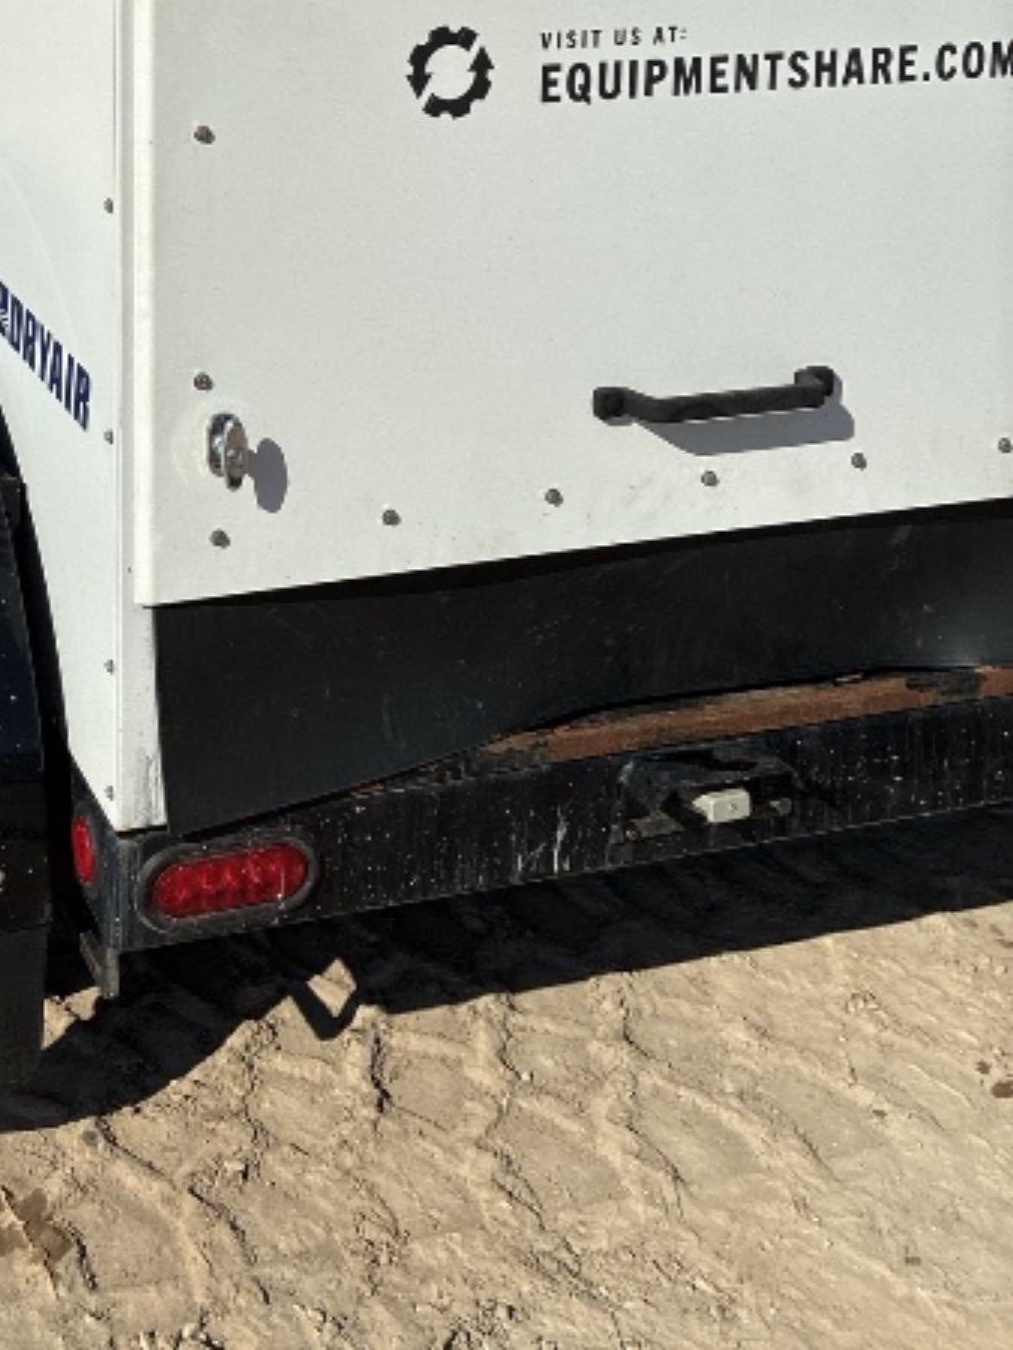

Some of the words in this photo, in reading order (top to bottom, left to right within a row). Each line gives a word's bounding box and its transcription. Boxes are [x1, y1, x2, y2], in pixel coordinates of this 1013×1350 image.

[539, 28, 603, 50] VISIT
[614, 27, 643, 46] US
[652, 25, 688, 45] AT:
[539, 39, 1013, 106] EQUIPMENTSHARE.COM
[8, 293, 92, 433] DRYAIR
